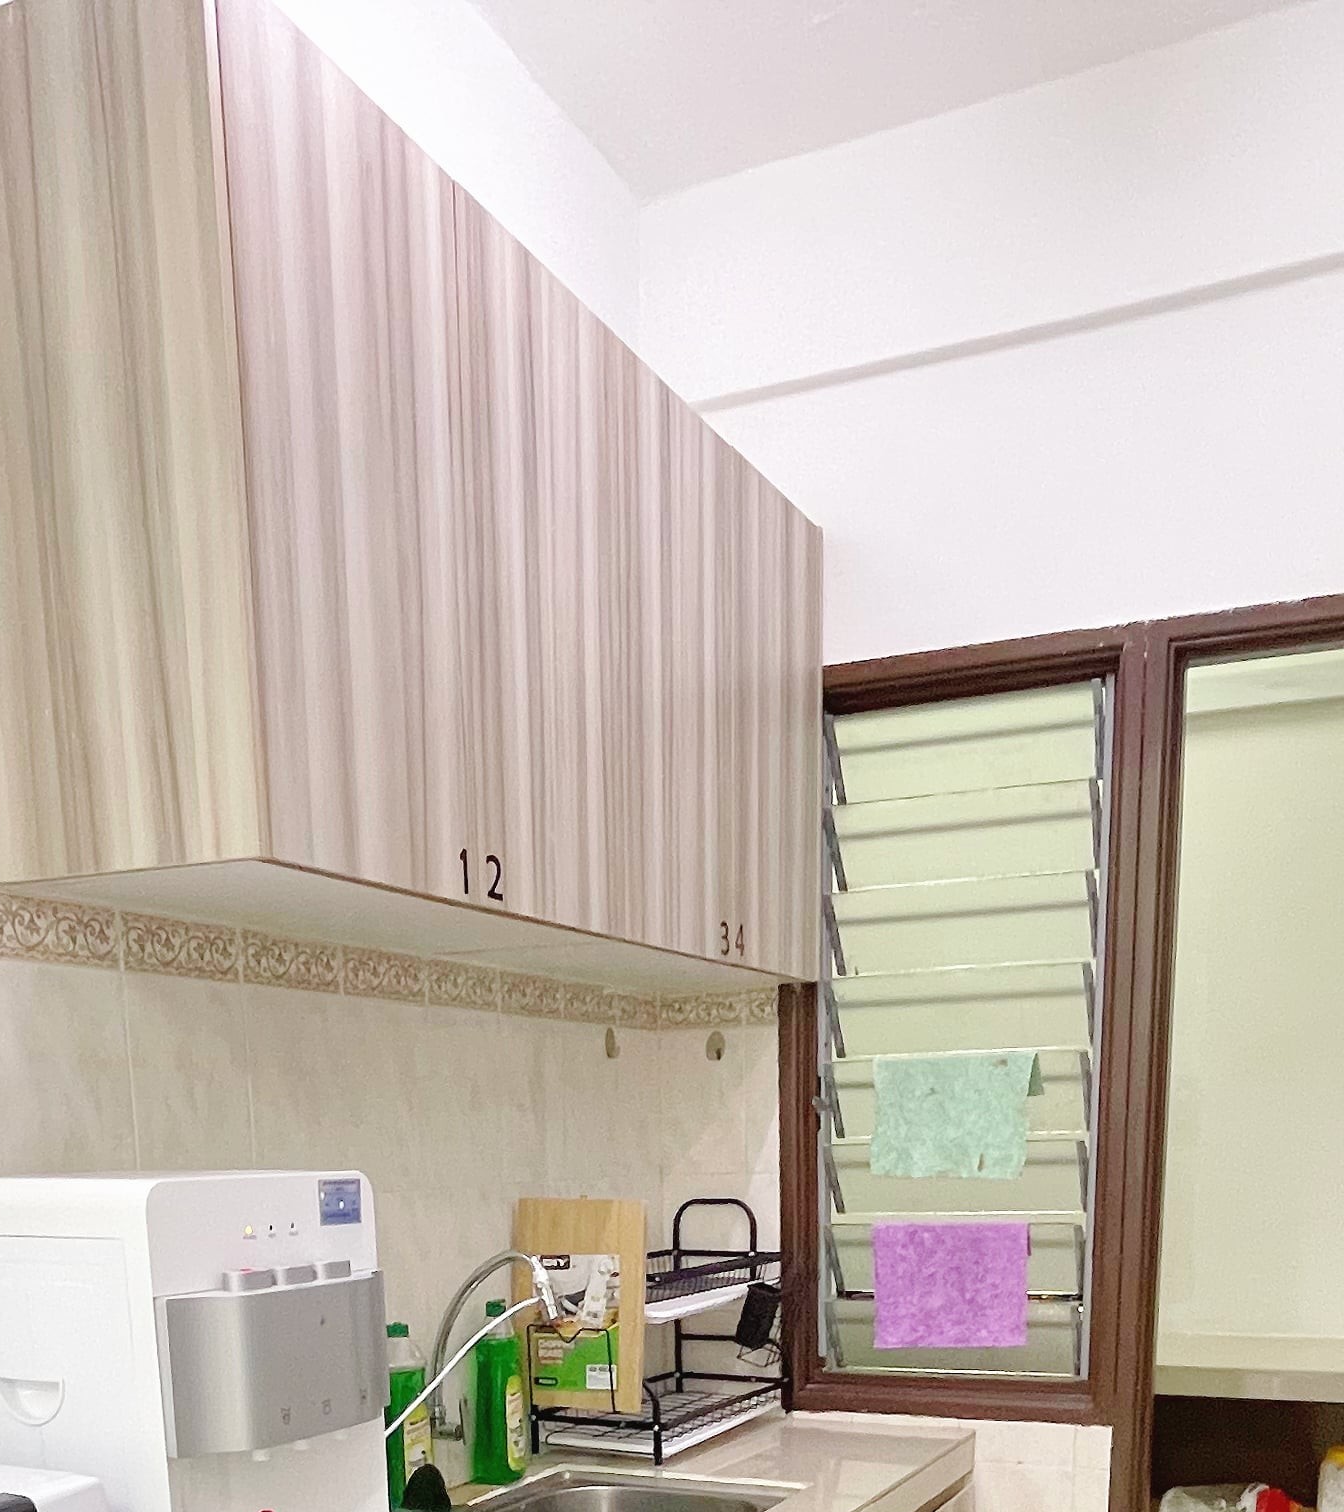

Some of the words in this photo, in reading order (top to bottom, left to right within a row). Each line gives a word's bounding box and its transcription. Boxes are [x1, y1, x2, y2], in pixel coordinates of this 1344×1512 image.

[459, 848, 470, 895] 1
[485, 854, 505, 902] 2
[719, 921, 731, 957] 3
[735, 923, 746, 957] 4
